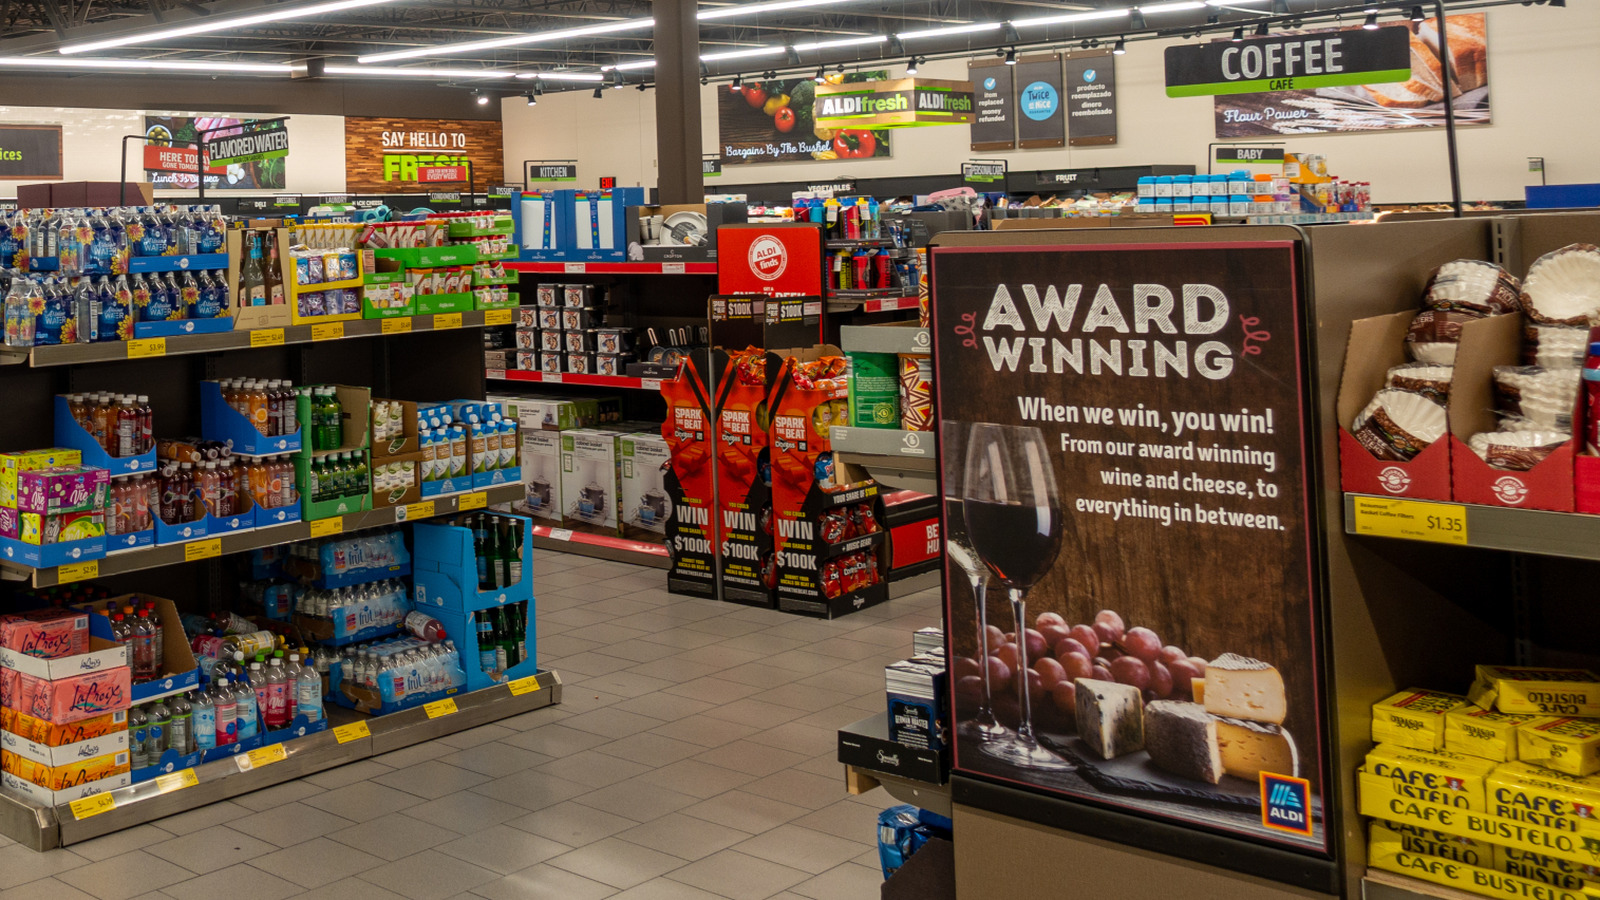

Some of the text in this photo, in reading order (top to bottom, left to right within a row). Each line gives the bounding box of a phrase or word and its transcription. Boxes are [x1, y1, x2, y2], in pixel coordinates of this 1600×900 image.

[1221, 38, 1343, 80] COFFEE
[1077, 84, 1105, 92] producto
[1269, 77, 1294, 91] CAFÉ
[919, 92, 971, 110] ALDIfresh
[1028, 90, 1050, 100] Twice
[1071, 91, 1112, 100] reemplazado
[822, 94, 907, 115] ALDIfresh
[978, 98, 1004, 106] replaced
[1035, 100, 1051, 109] Nice
[1081, 100, 1102, 108] dinero
[982, 108, 1001, 116] money
[1072, 107, 1112, 117] reembolsado
[1223, 106, 1309, 123] Flour Power
[978, 115, 1005, 123] refunded
[210, 137, 255, 160] FLAVORED
[255, 131, 288, 152] WATER
[382, 131, 465, 148] SAY HELLO TO
[0, 150, 22, 161] ices
[725, 140, 831, 158] Bargains By The Bushel
[1237, 149, 1263, 160] BABY
[160, 152, 182, 162] HERE
[178, 163, 210, 172] TOMORW
[540, 167, 567, 178] KITCHEN
[152, 172, 178, 183] Lunch
[1055, 174, 1077, 182] FRUIT
[807, 184, 851, 192] VEGETABLES
[756, 246, 777, 259] ALDI
[760, 257, 779, 270] finds
[728, 302, 752, 316] $100K
[780, 304, 802, 318] $100K
[982, 283, 1230, 335] AWARD
[150, 344, 164, 352] $3.99
[982, 336, 1234, 380] WINNING
[674, 408, 702, 420] SPARK
[722, 410, 750, 423] SPARK
[1017, 396, 1274, 437] When we win, you win!
[684, 420, 702, 430] BEAT
[732, 422, 750, 434] BEAT
[775, 416, 804, 428] SPARK
[786, 428, 806, 440] BEAT
[1060, 433, 1276, 473] From our award winning
[1100, 467, 1278, 500] wine and cheese, to
[846, 492, 860, 502] SHARE
[860, 490, 865, 498] OF
[1360, 502, 1388, 510] Beaumont
[676, 505, 708, 526] WIN
[1075, 497, 1286, 531] everything in between.
[723, 510, 756, 532] WIN
[1427, 515, 1463, 532] $1.35
[778, 518, 814, 540] WIN
[926, 523, 939, 539] BE
[674, 534, 712, 554] $100K
[846, 541, 860, 552] MUSIC
[722, 541, 760, 561] $100K
[776, 550, 818, 571] $100K
[83, 565, 97, 574] $2.99
[21, 631, 68, 658] LaCroix
[69, 682, 121, 712] LaCroix
[1528, 692, 1587, 705] BUSTELO
[1270, 807, 1304, 823] ALDI
[1467, 815, 1573, 852] BUSTELO
[1402, 836, 1478, 865] USTELO
[1473, 870, 1578, 900] BUSTELO
